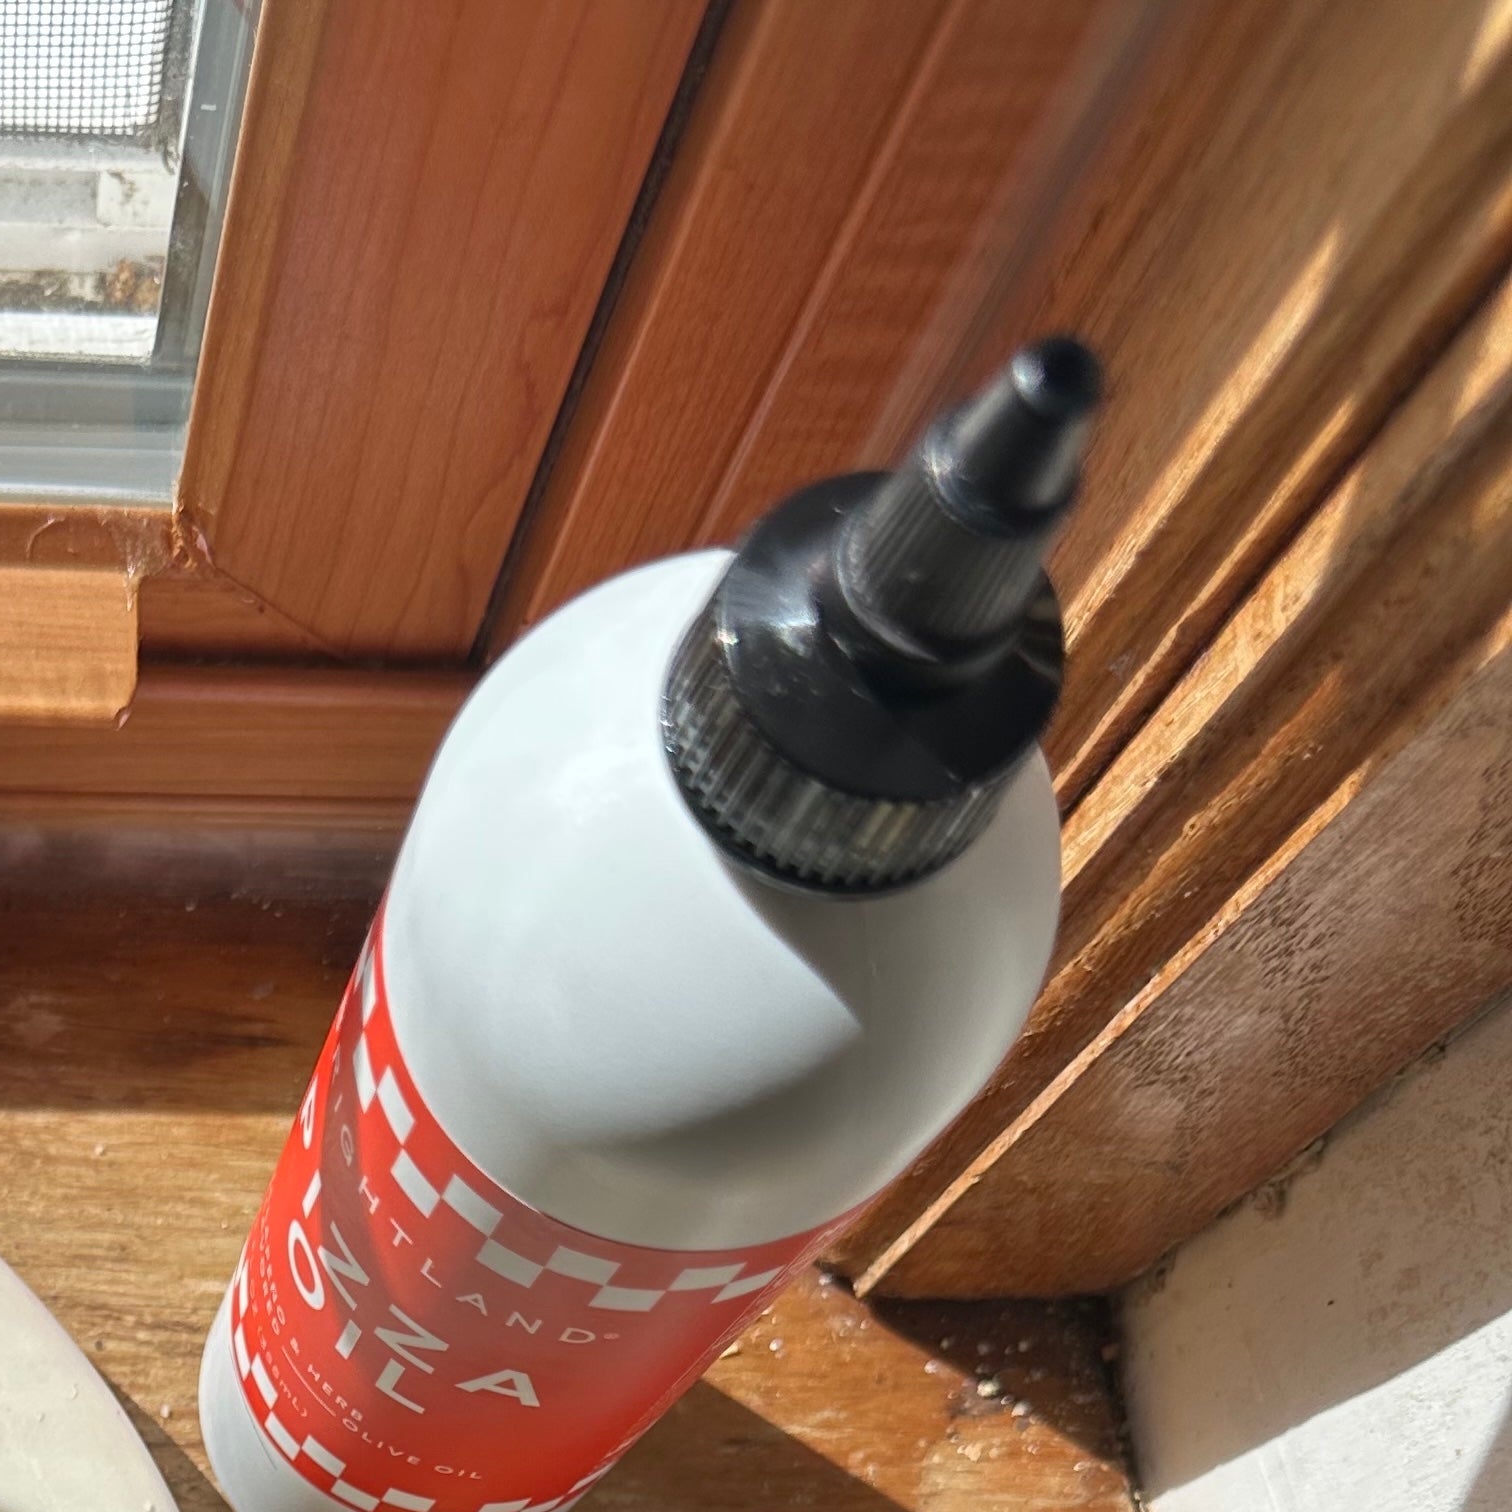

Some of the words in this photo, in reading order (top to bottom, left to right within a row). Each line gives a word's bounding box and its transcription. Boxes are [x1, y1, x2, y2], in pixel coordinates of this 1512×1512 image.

[299, 1072, 541, 1408] PIZZA
[287, 1218, 426, 1416] OIL
[307, 1363, 363, 1422] HERB
[342, 1417, 421, 1466] OLIVE
[434, 1465, 482, 1480] OIL
